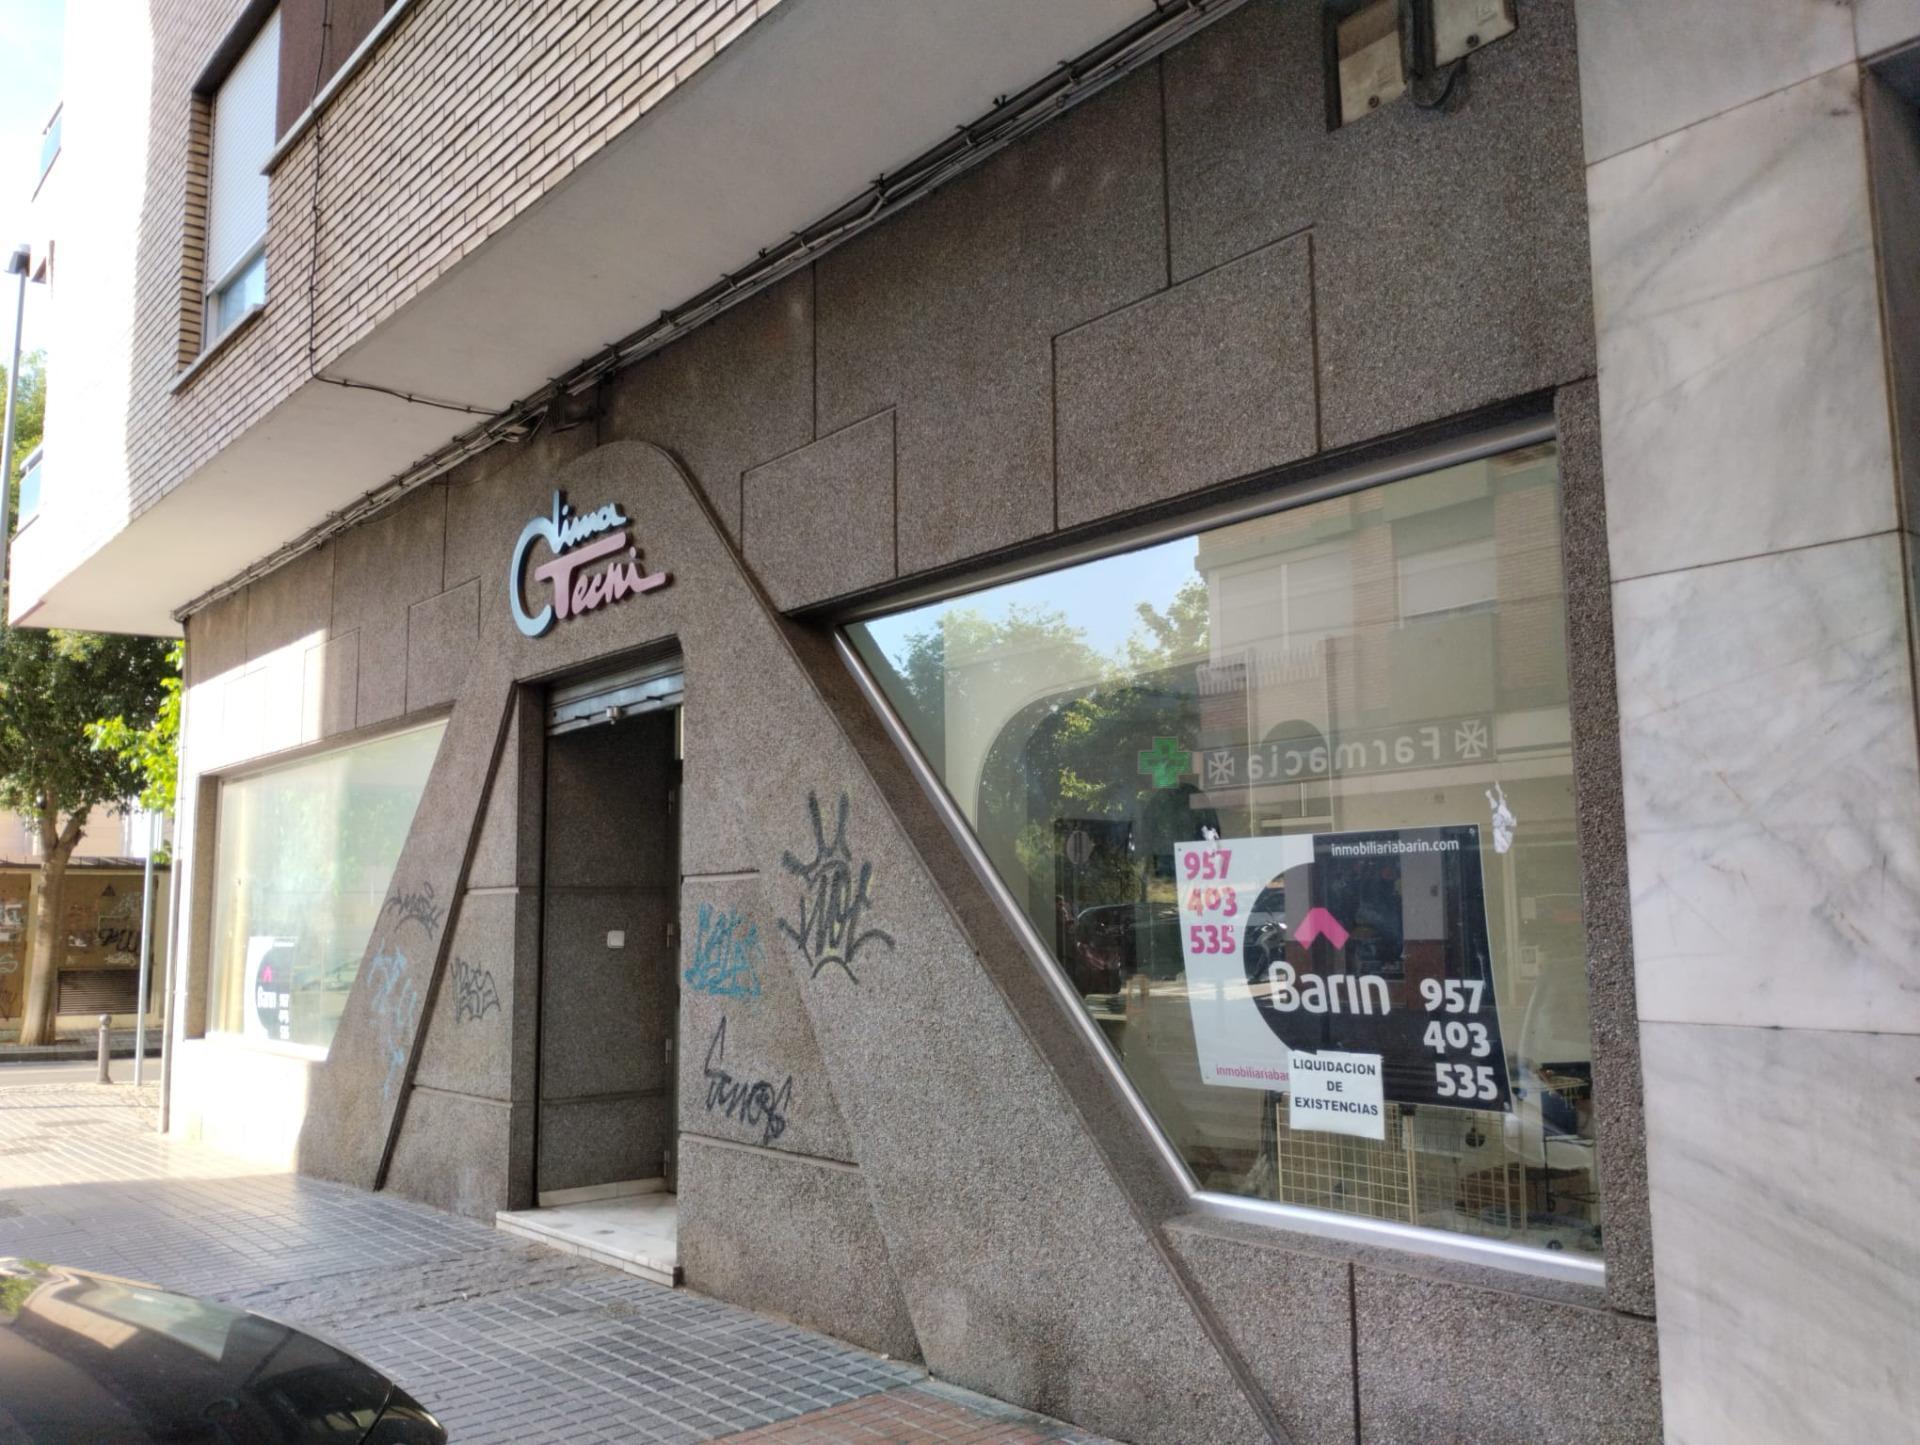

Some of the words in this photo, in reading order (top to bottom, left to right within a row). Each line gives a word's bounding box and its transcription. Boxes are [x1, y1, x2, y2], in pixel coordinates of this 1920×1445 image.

[510, 489, 627, 637] Clima
[534, 532, 666, 619] Tecni
[1331, 839, 1460, 857] inmobiliariabarin.com
[1183, 849, 1232, 880] 957
[1187, 887, 1238, 917] 403
[1190, 925, 1236, 954] 535
[1268, 960, 1391, 1016] Barin
[1420, 978, 1486, 1014] 957
[1423, 1020, 1491, 1057] 403
[1292, 1058, 1376, 1076] LIQUIDACION
[1435, 1063, 1498, 1100] 535
[1326, 1080, 1343, 1092] DE
[1295, 1097, 1378, 1116] EXISTENCIAS
